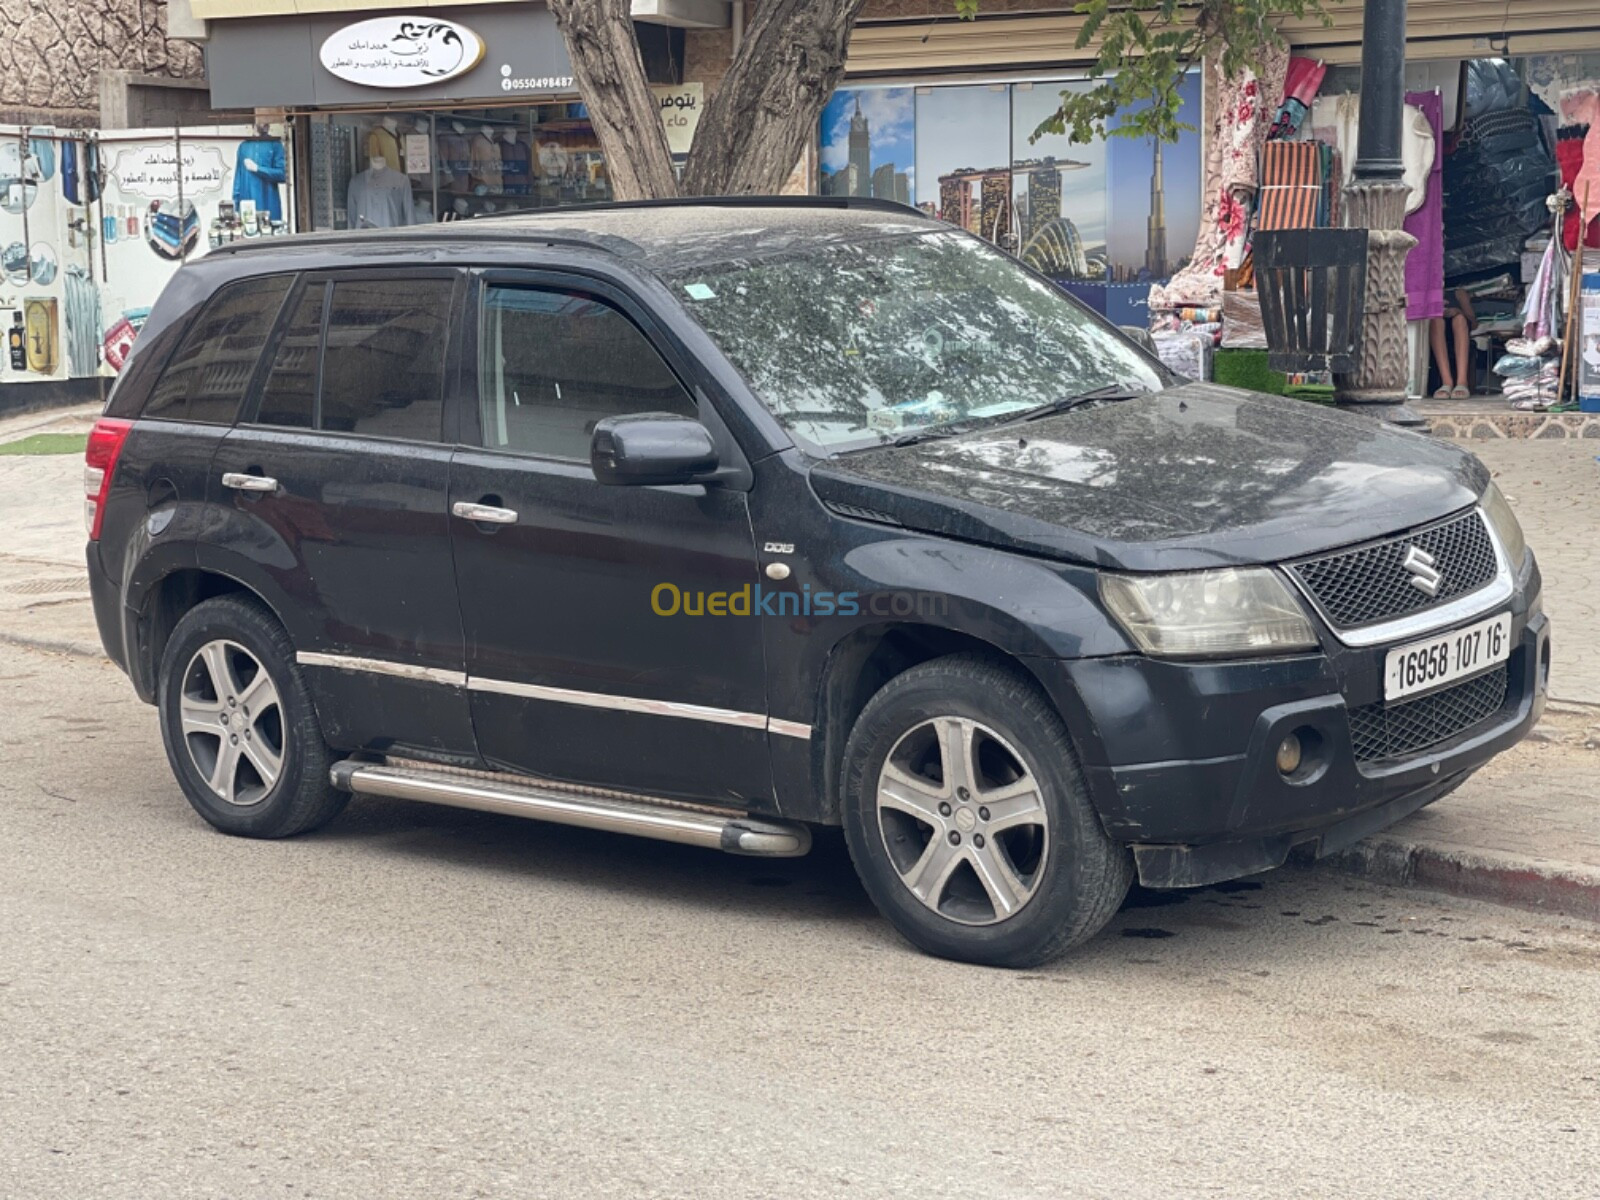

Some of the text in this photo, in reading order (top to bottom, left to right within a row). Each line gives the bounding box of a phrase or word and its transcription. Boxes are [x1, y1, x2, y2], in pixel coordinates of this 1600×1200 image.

[390, 42, 430, 56] زين
[512, 77, 574, 90] 0550498487
[667, 114, 688, 127] ماء
[1398, 622, 1503, 690] 16958 107 16
